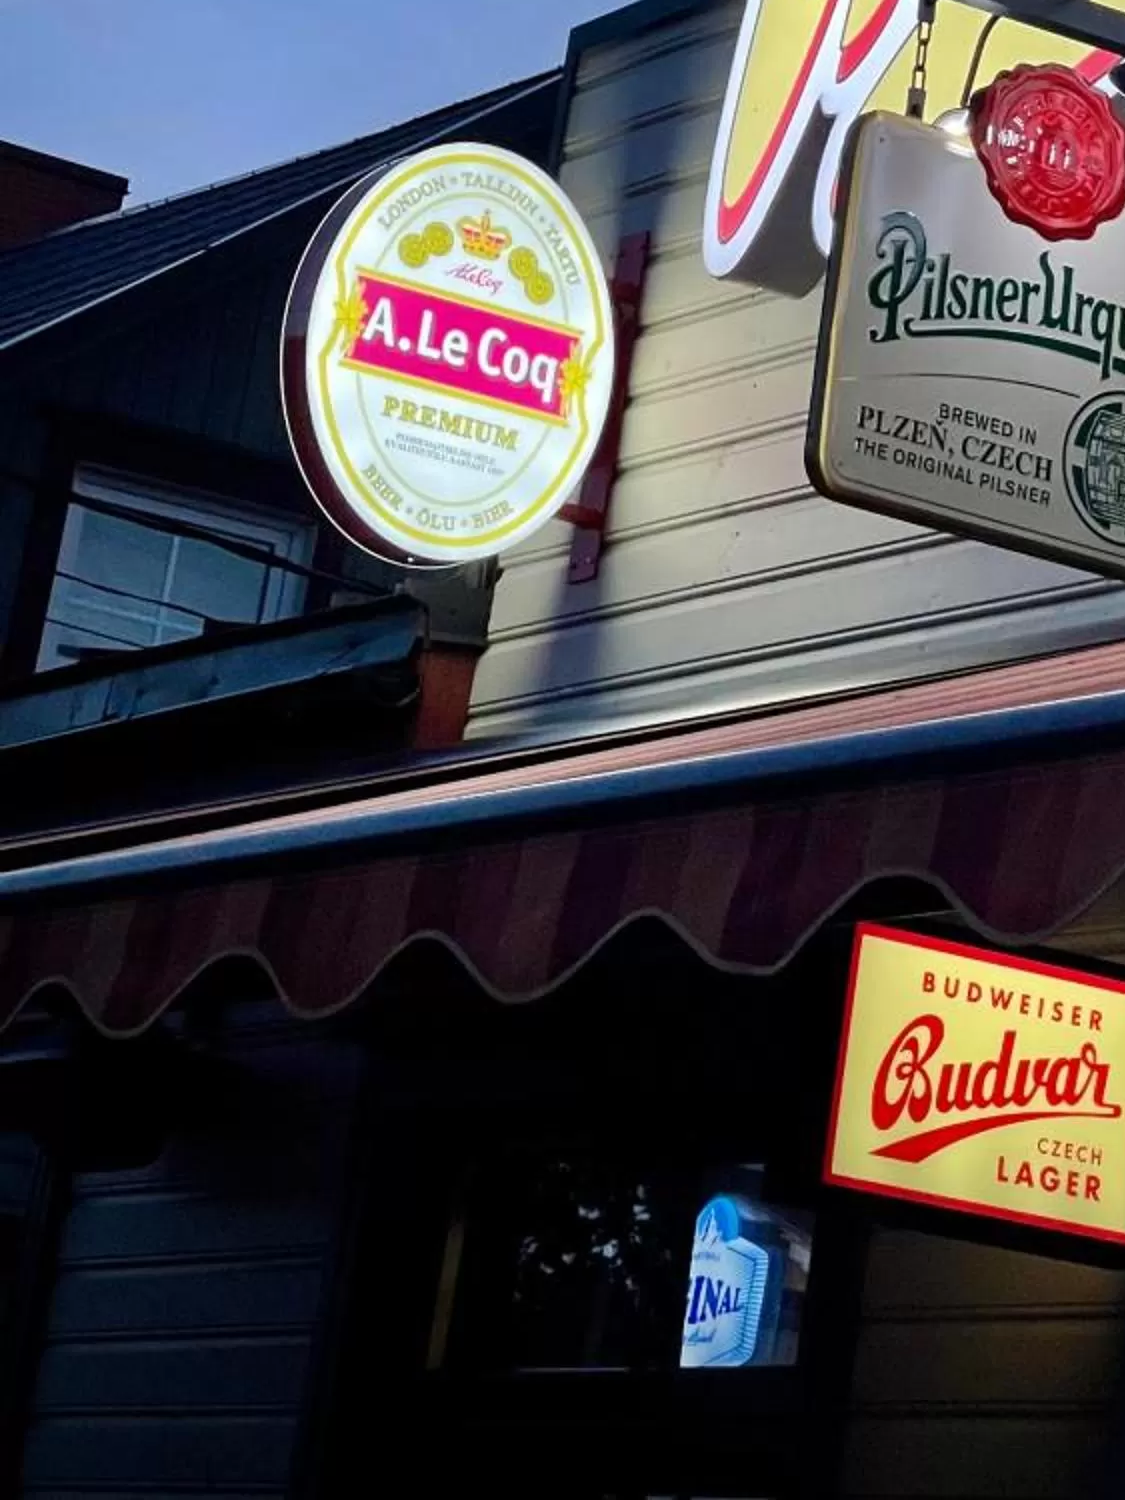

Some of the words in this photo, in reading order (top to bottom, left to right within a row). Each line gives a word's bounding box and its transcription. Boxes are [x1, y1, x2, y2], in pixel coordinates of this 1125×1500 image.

[378, 174, 446, 231] LONDON
[461, 171, 540, 217] TALLINN
[544, 222, 582, 286] TARTU
[867, 211, 1041, 343] Pilsner
[380, 395, 520, 451] PREMIUM
[938, 402, 1014, 439] BREWED
[1018, 423, 1038, 445] IN
[854, 436, 888, 462] THE
[892, 445, 975, 486] ORIGINAL
[978, 467, 1052, 507] PILSNER
[960, 436, 1054, 482] CZECH
[362, 462, 404, 512] BEER
[471, 499, 515, 529] BIER
[921, 970, 1104, 1032] BUDWEISER
[871, 1013, 1122, 1131] Budvar
[996, 1154, 1102, 1202] LAGER
[1036, 1137, 1103, 1167] CZECH
